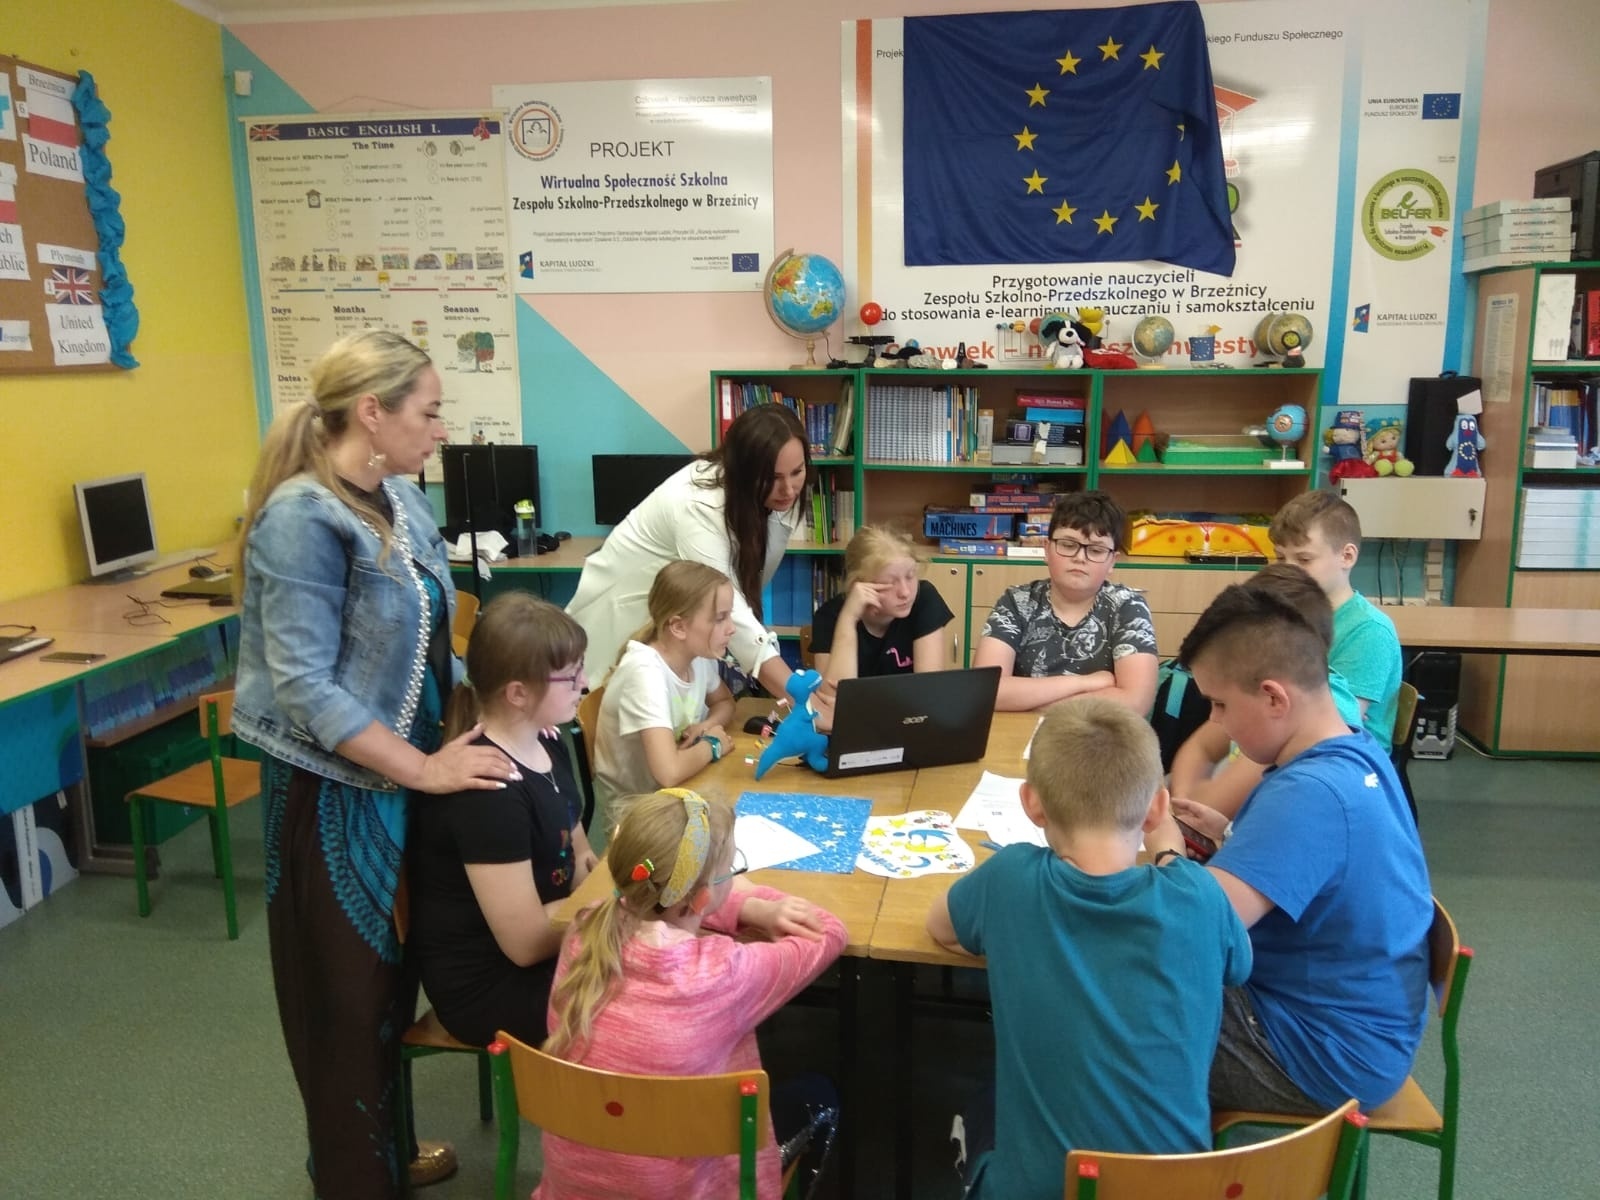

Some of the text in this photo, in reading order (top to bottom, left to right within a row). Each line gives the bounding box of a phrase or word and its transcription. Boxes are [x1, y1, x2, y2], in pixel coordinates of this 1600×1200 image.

[1234, 32, 1280, 42] Funduszu
[1282, 30, 1343, 42] Społecznego
[876, 48, 904, 59] Projek
[307, 126, 350, 138] BASIC
[358, 124, 422, 136] ENGLISH
[352, 141, 394, 150] The Time
[590, 140, 675, 158] PROJEKT
[28, 142, 78, 172] Poland
[540, 172, 728, 192] Wirtualna Społeczność Szkolna
[512, 194, 759, 213] Zespołu Szkolno-Przedszkolnego w Brzeźnicy
[1381, 208, 1432, 220] BELFER
[992, 270, 1195, 290] Przygotowanie nauczycieli
[924, 283, 1267, 308] Zespołu Szkolno-Przedszkolnego w Brzeźnicy
[272, 306, 292, 315] Days
[333, 305, 366, 313] Months
[443, 305, 479, 313] Seasons
[881, 308, 896, 321] do
[901, 306, 980, 320] stosowania
[1176, 301, 1181, 314] i
[1186, 297, 1315, 313] samokształceniu
[60, 315, 94, 330] United
[57, 339, 106, 356] Kingdom
[278, 374, 301, 382] Dates
[931, 522, 977, 536] MACHINES
[903, 716, 928, 725] acer
